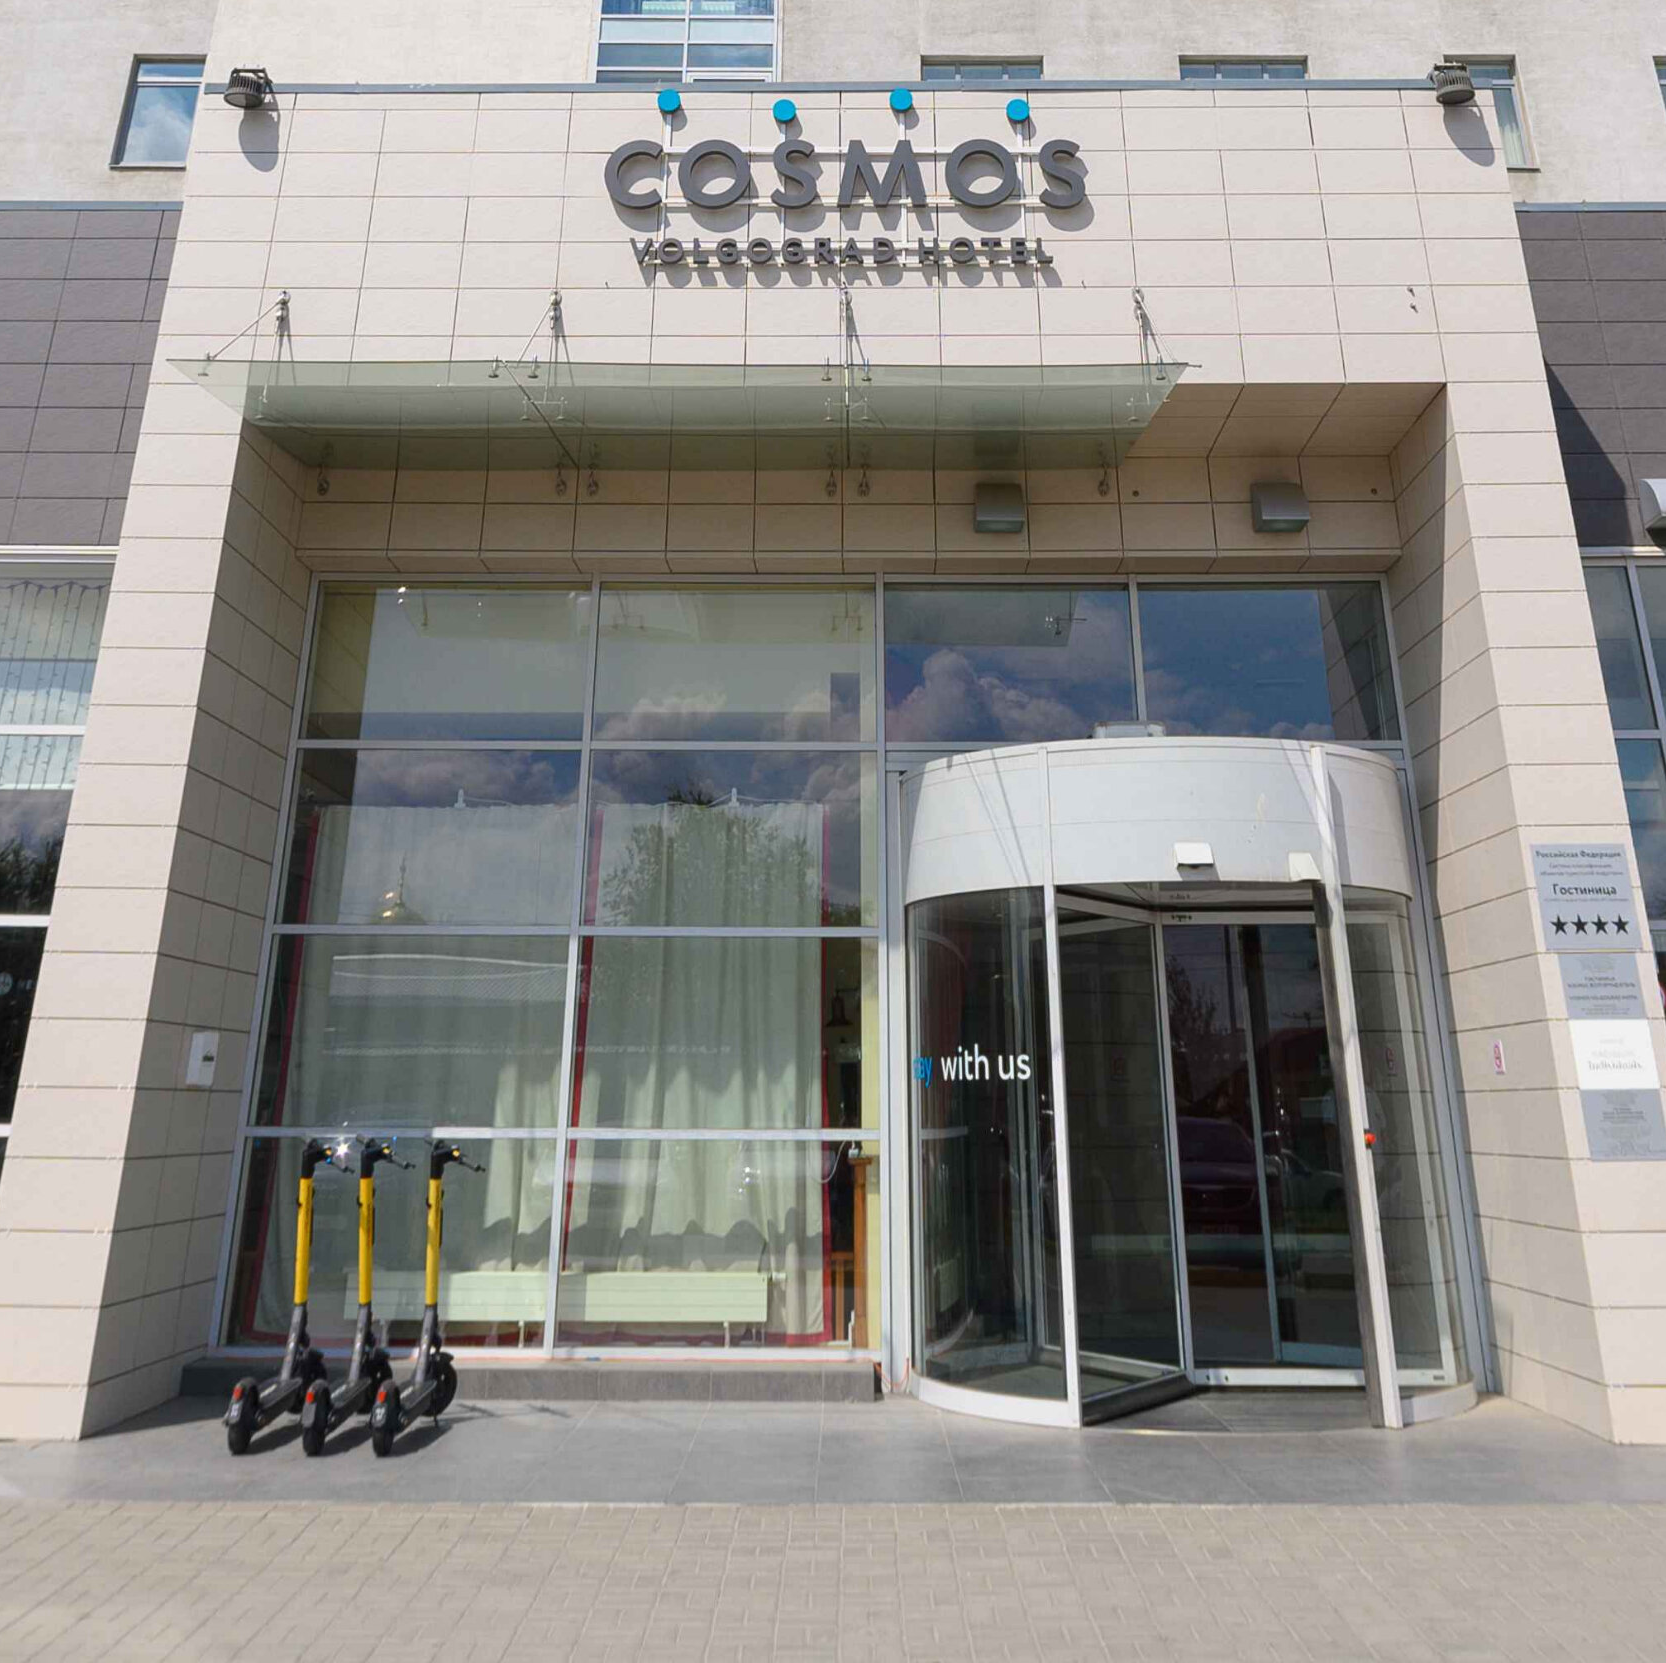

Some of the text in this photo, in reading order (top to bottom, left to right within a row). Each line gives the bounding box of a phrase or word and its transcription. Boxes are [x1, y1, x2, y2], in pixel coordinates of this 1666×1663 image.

[604, 139, 1086, 209] COSMOS
[630, 236, 1054, 264] VOLGOGRAD HOTEL
[1553, 883, 1617, 896] Гостиница
[940, 1043, 990, 1081] with
[998, 1054, 1031, 1080] us
